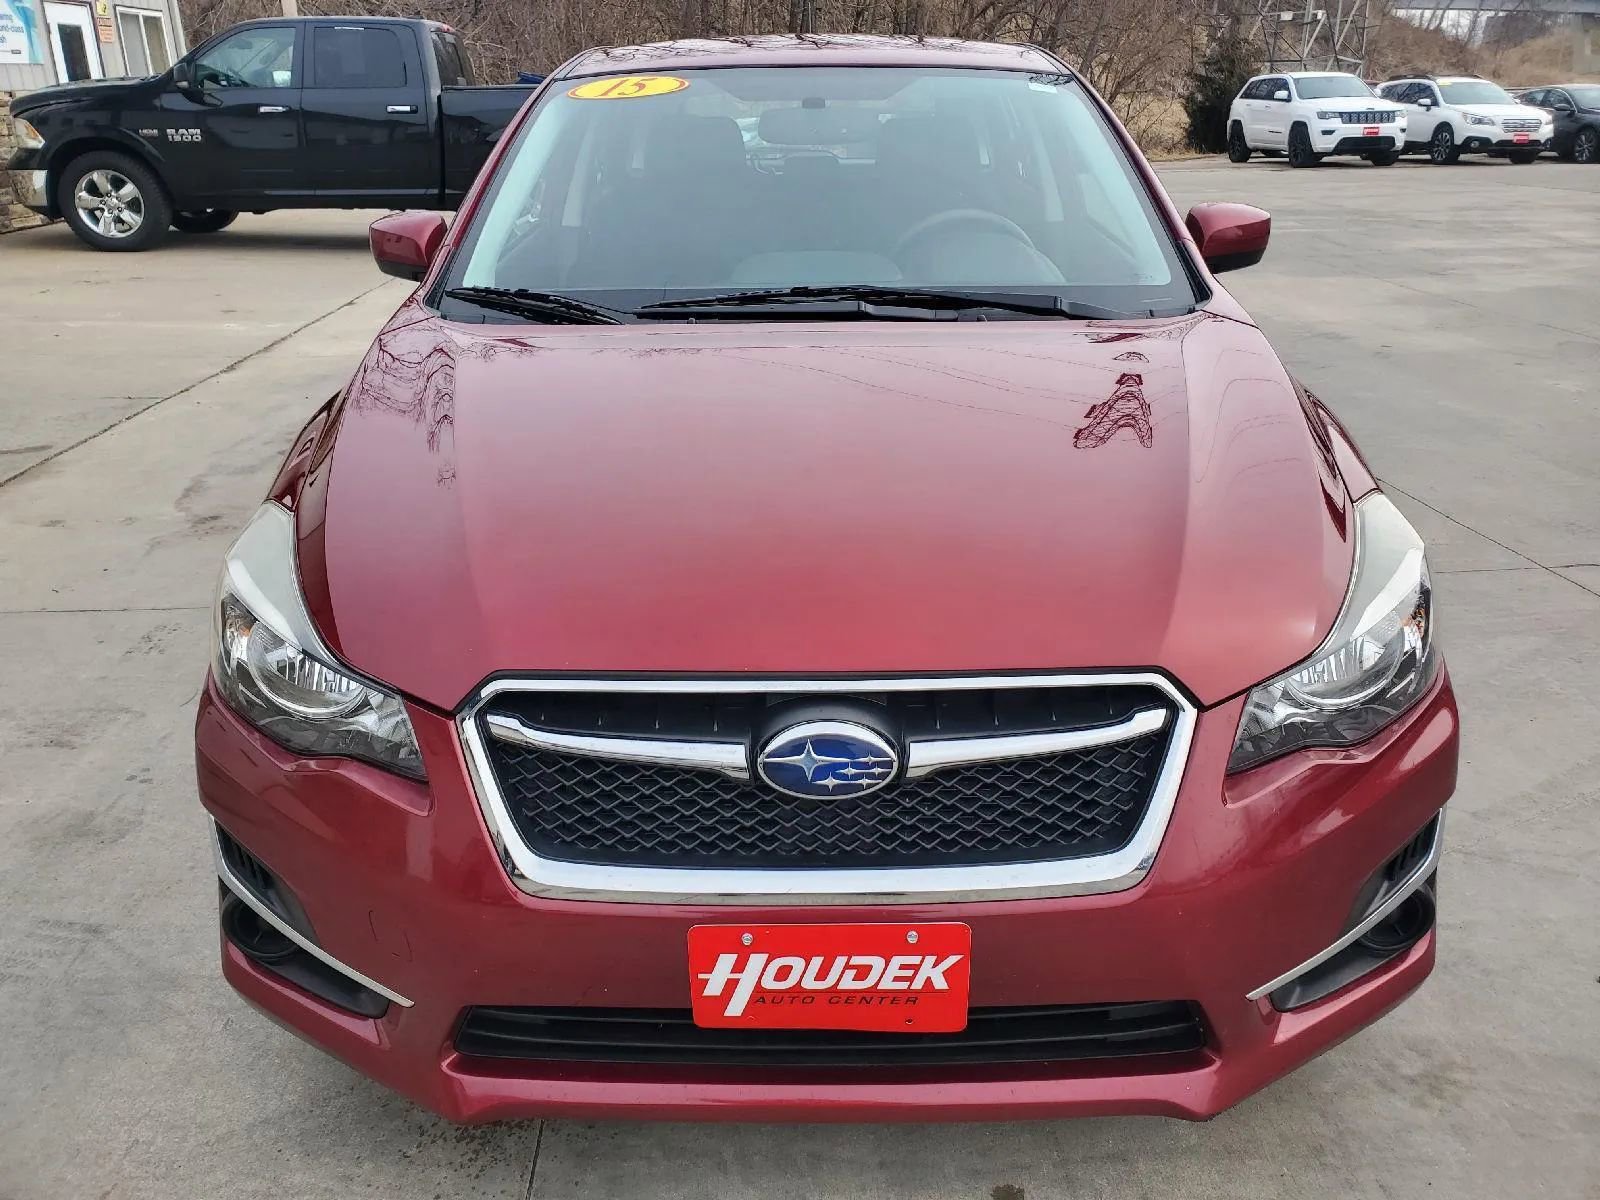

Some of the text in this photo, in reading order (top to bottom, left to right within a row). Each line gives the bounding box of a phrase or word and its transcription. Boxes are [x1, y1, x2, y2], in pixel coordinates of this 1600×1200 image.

[595, 78, 659, 98] 15
[698, 953, 965, 1017] HOUDEK
[755, 995, 919, 1005] AUTO CENTER
